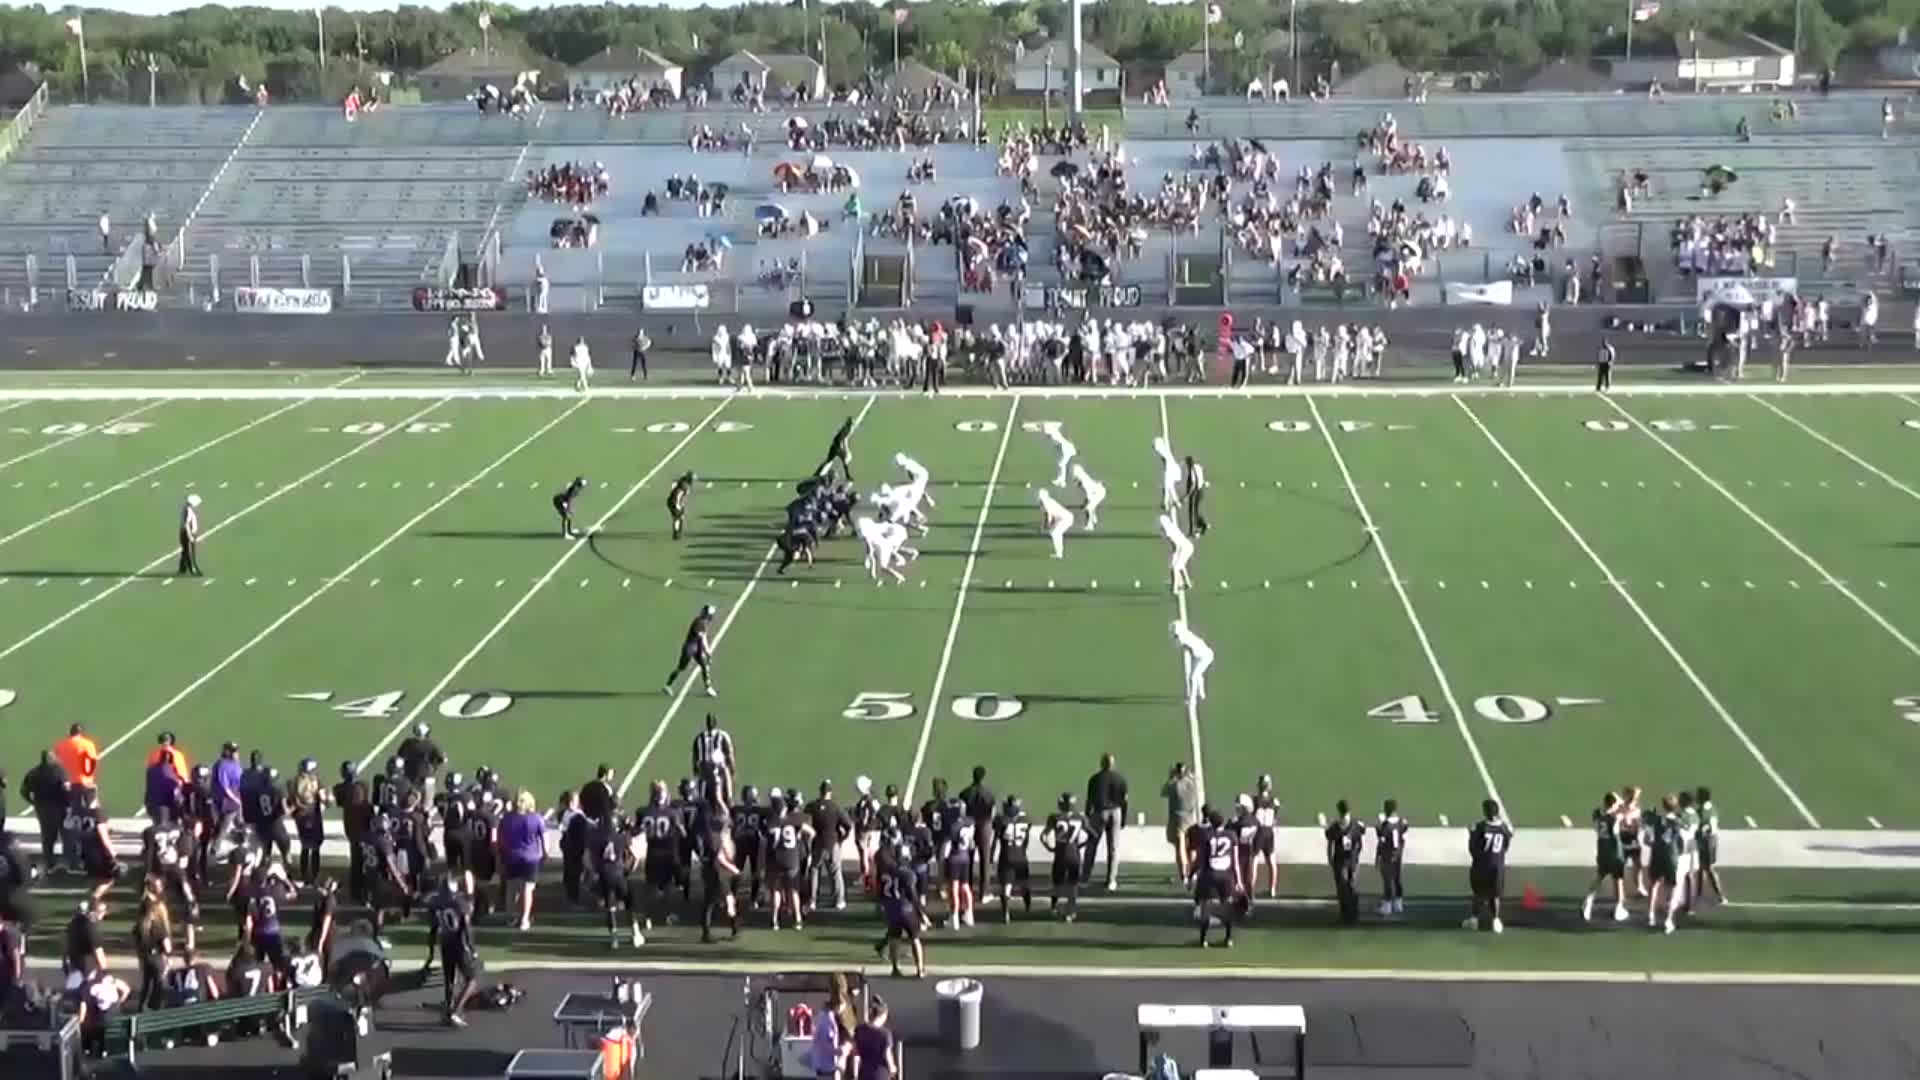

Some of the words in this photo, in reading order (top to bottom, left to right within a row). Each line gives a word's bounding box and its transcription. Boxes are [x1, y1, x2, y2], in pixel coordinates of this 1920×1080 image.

[332, 690, 516, 719] 40
[842, 692, 1025, 720] 50
[1367, 695, 1549, 723] 40
